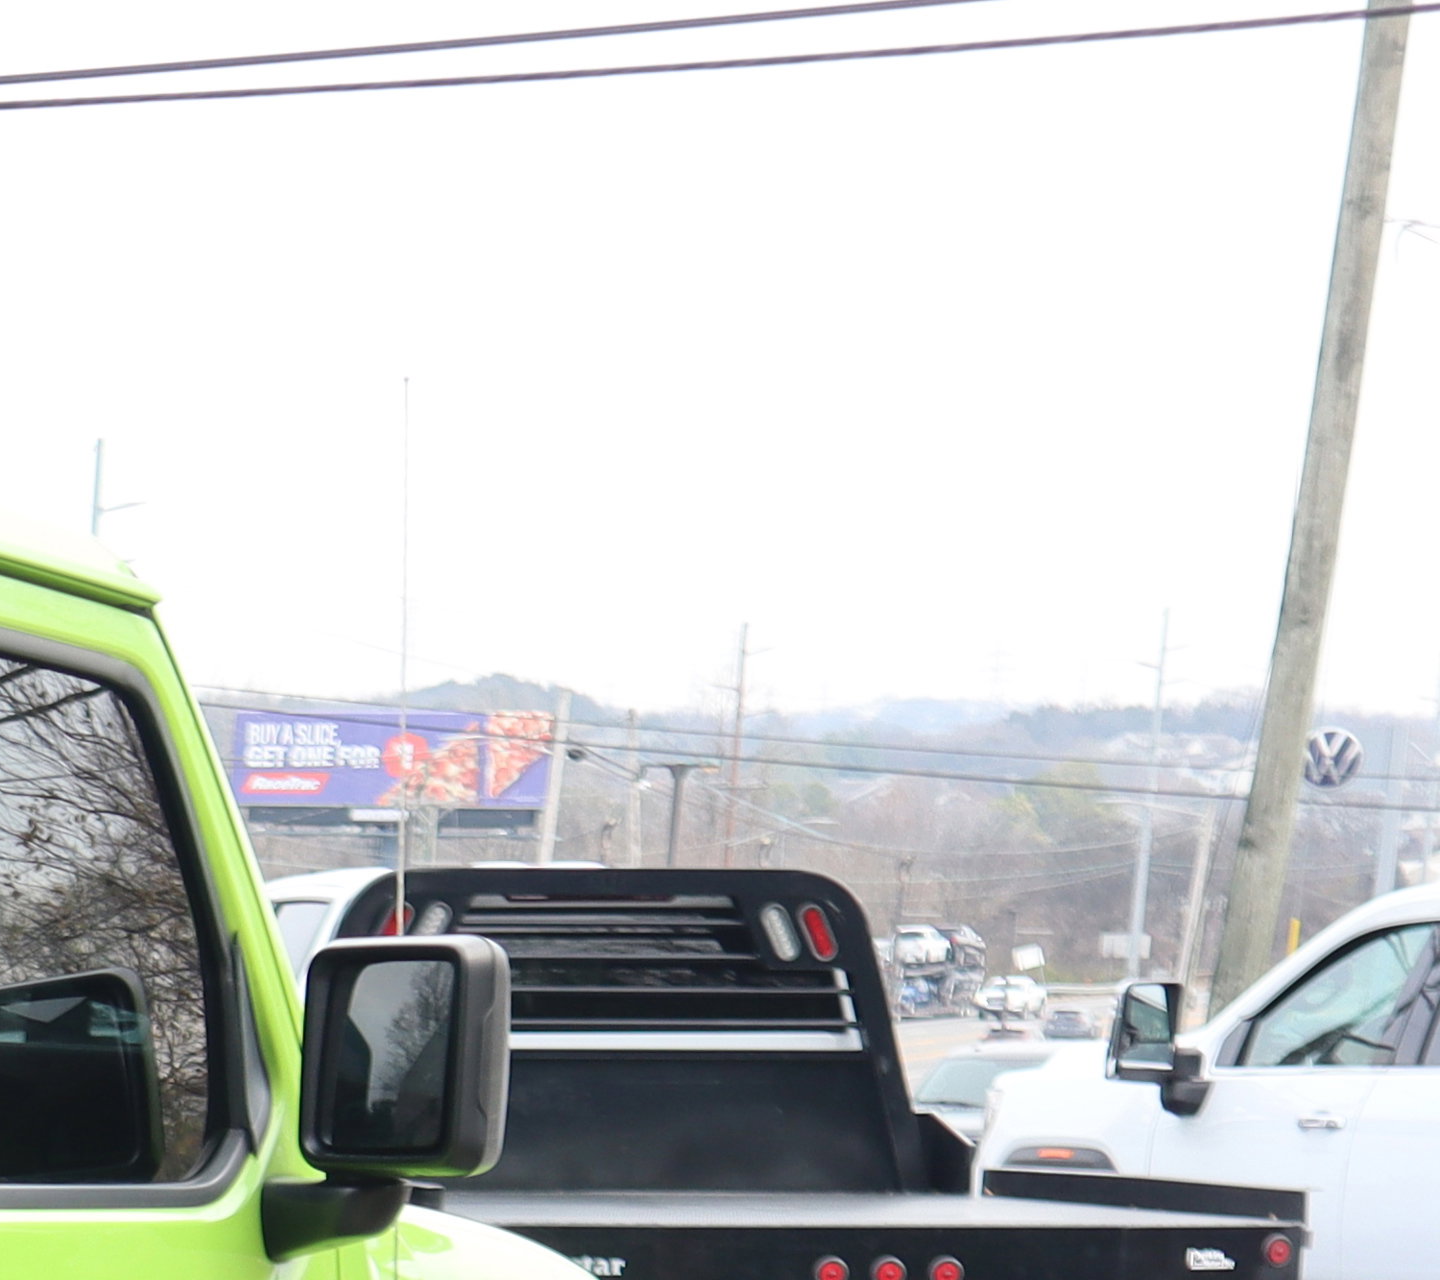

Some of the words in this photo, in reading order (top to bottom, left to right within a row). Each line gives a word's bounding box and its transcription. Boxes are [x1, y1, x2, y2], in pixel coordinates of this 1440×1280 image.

[247, 722, 280, 745] BUY
[280, 723, 295, 745] A
[245, 746, 288, 768] GET
[288, 746, 335, 768] ONE
[335, 745, 380, 769] FOR
